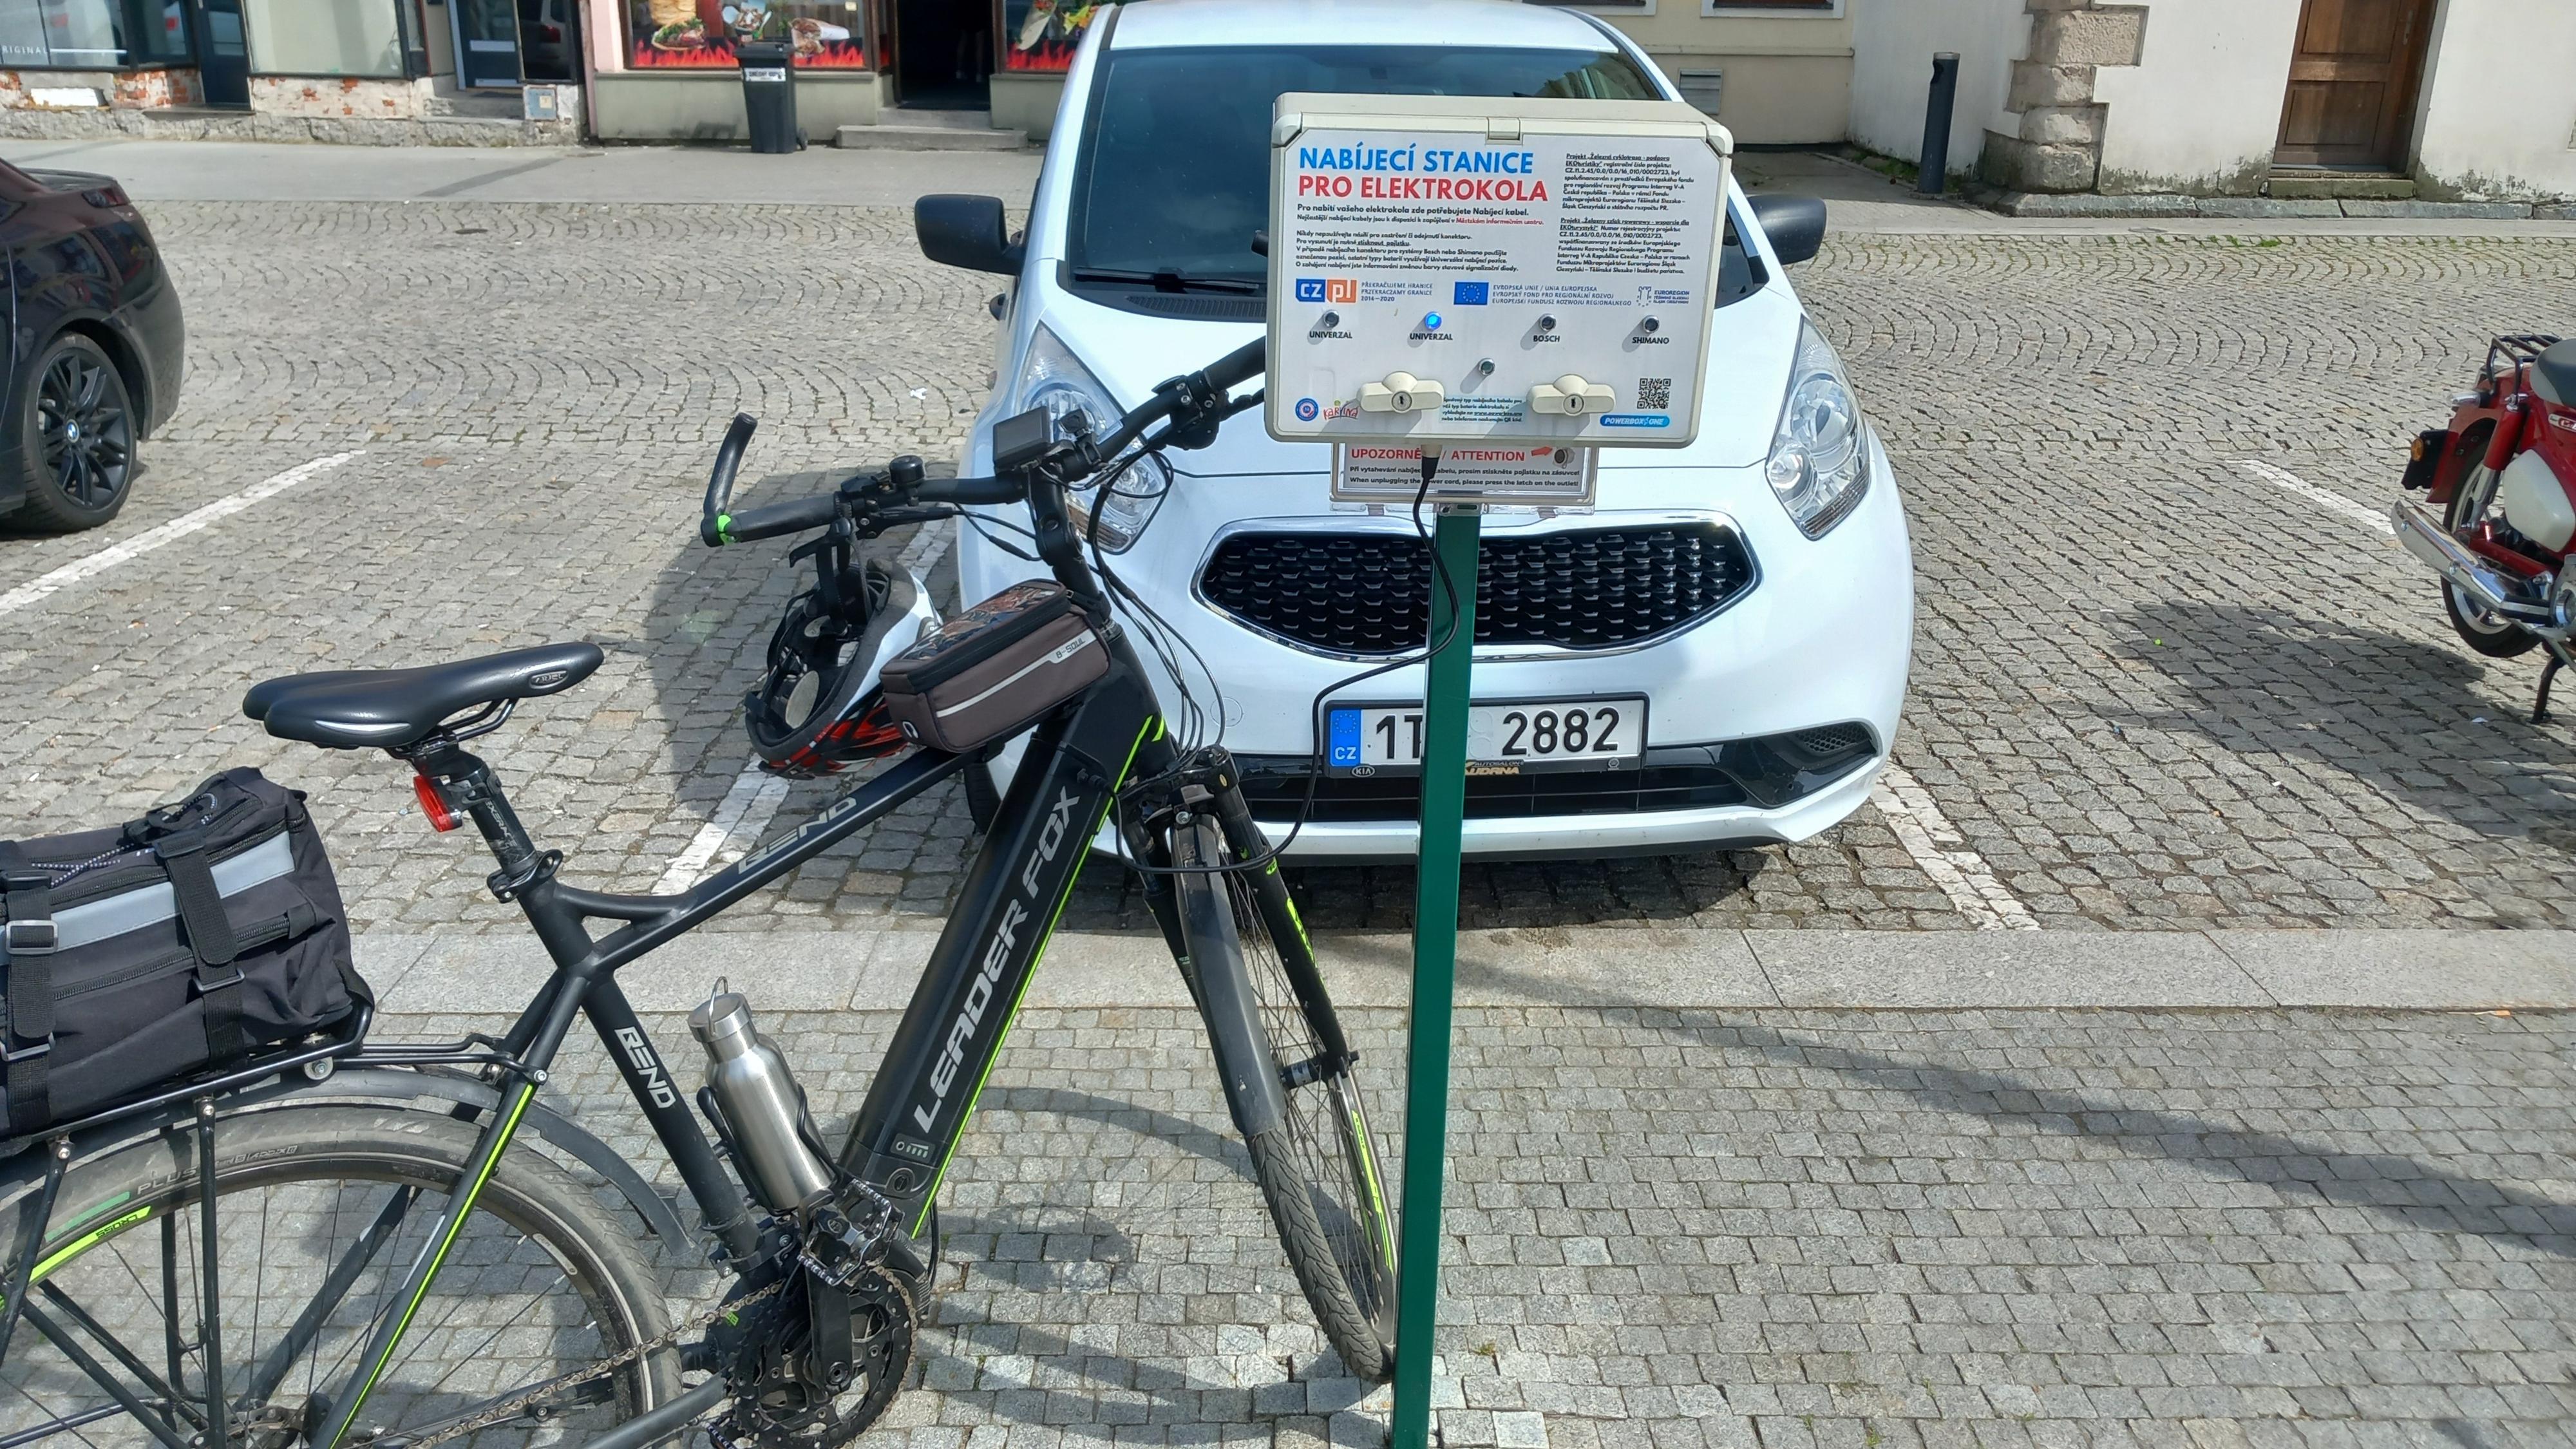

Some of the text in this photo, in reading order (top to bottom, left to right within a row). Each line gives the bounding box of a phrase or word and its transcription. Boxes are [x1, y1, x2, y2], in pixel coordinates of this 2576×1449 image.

[1300, 142, 1533, 174] NABÍJECÍ STANICE
[1299, 175, 1548, 202] PRO ELEKTROKOLA
[1337, 204, 1363, 213] vašeho
[1365, 205, 1409, 213] elektrokola
[1427, 206, 1471, 216] potřebujete
[1472, 207, 1504, 217] Nabíjecí
[1300, 283, 1323, 298] CZ
[1351, 448, 1421, 460] UPOZORNĚ
[1451, 450, 1525, 461] ATTENTION
[1502, 707, 1620, 755] 2882
[1335, 746, 1357, 760] CZ
[913, 786, 1080, 1133] LEADER FOX
[138, 1165, 198, 1195] PLUS
[96, 1213, 138, 1238] CROSS
